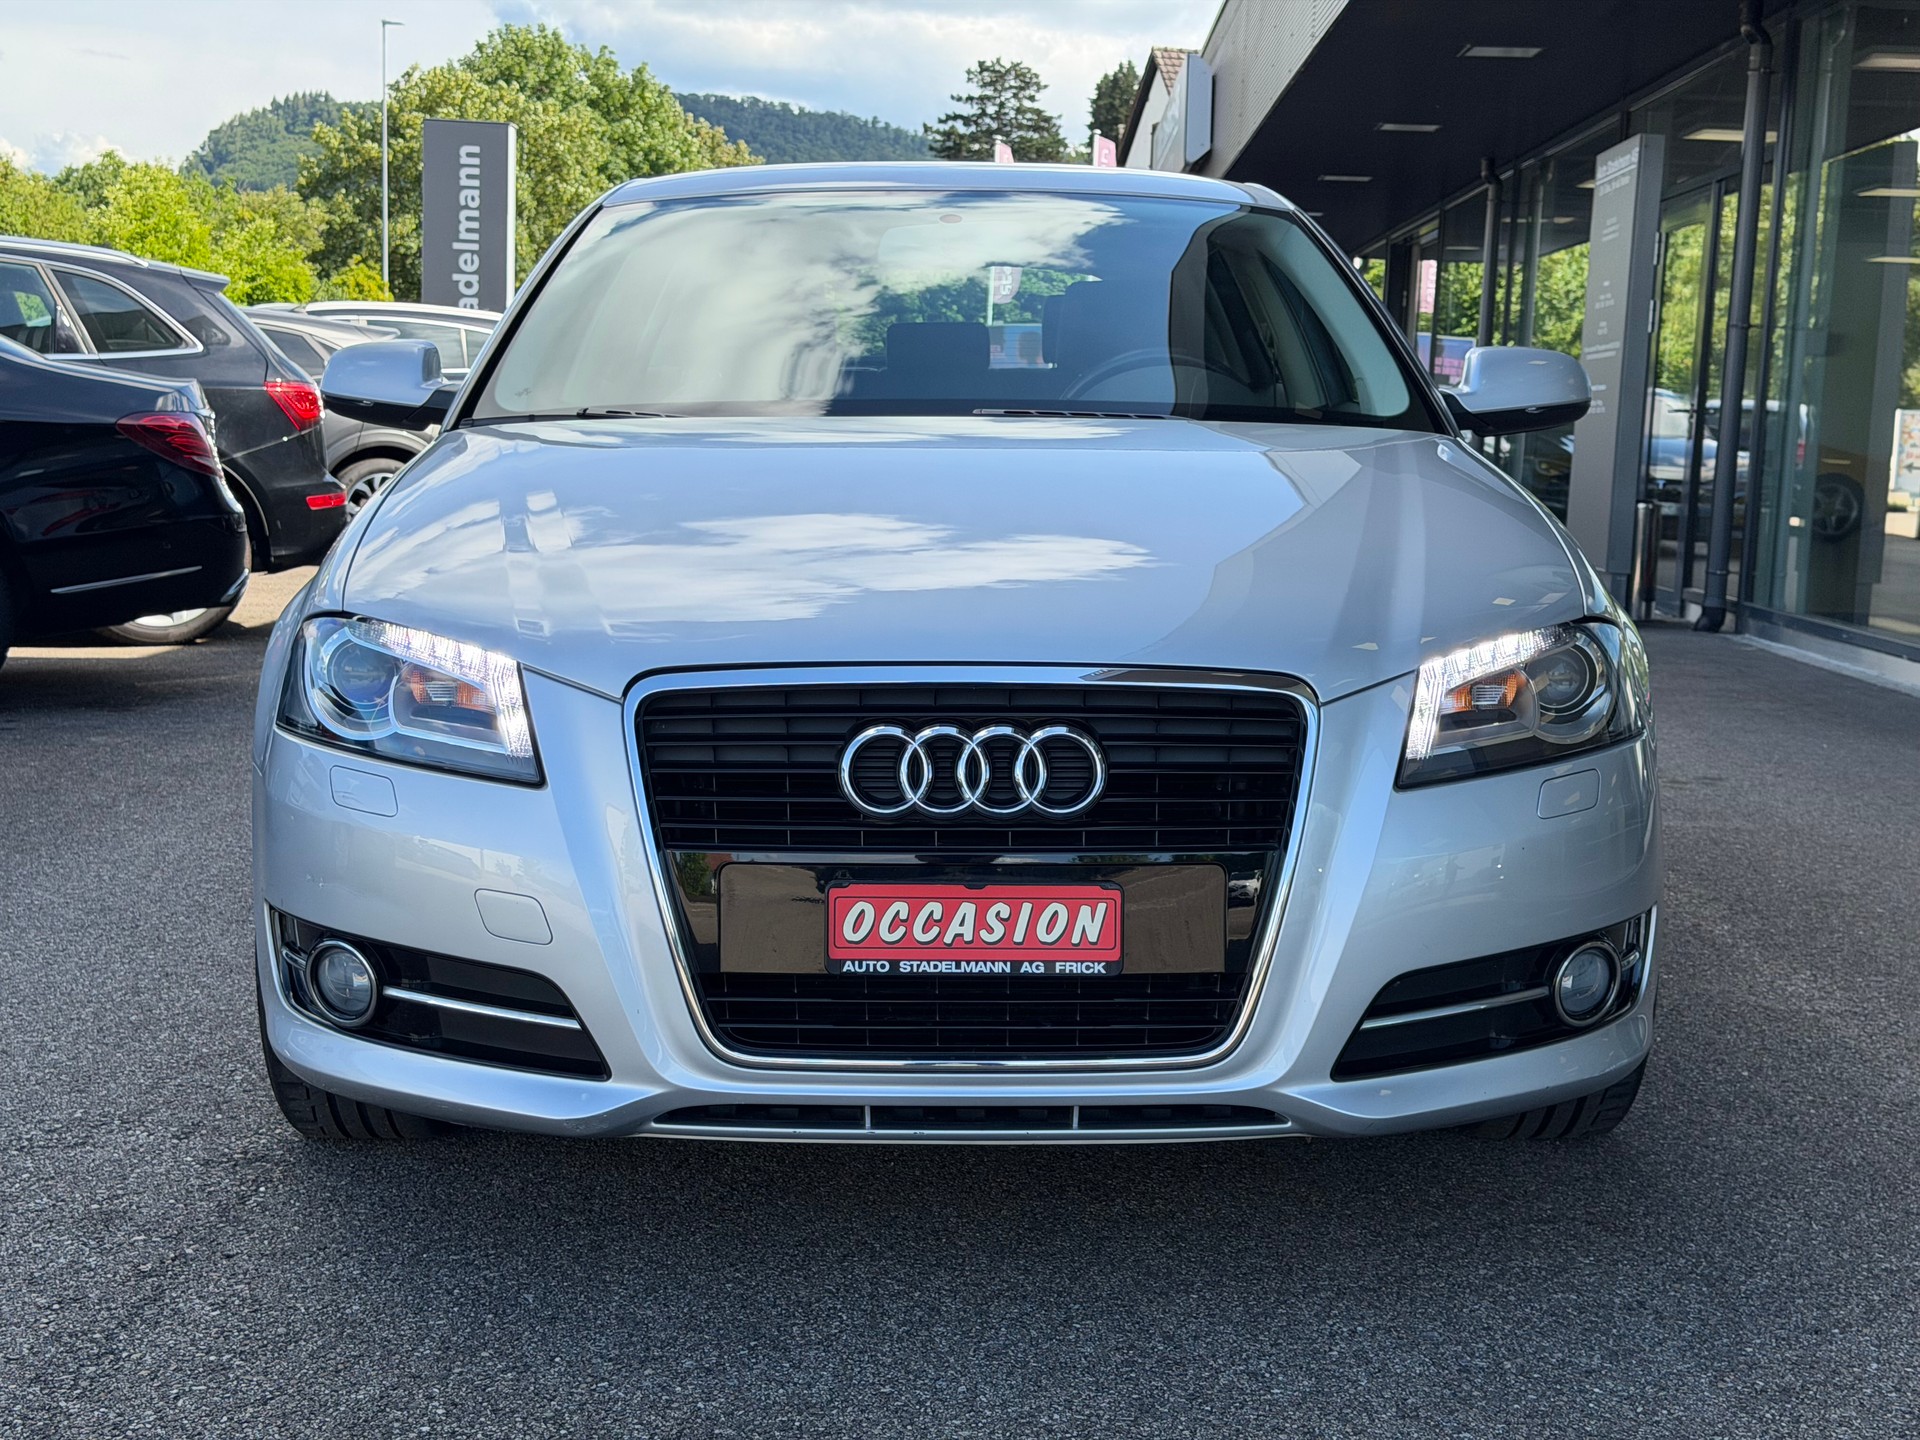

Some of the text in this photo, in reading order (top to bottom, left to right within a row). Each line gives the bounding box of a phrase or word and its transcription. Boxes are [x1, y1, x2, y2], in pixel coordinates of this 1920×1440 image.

[842, 900, 1108, 946] OCCASION
[842, 960, 1106, 974] AUTO STADELMANN AG FRICK
